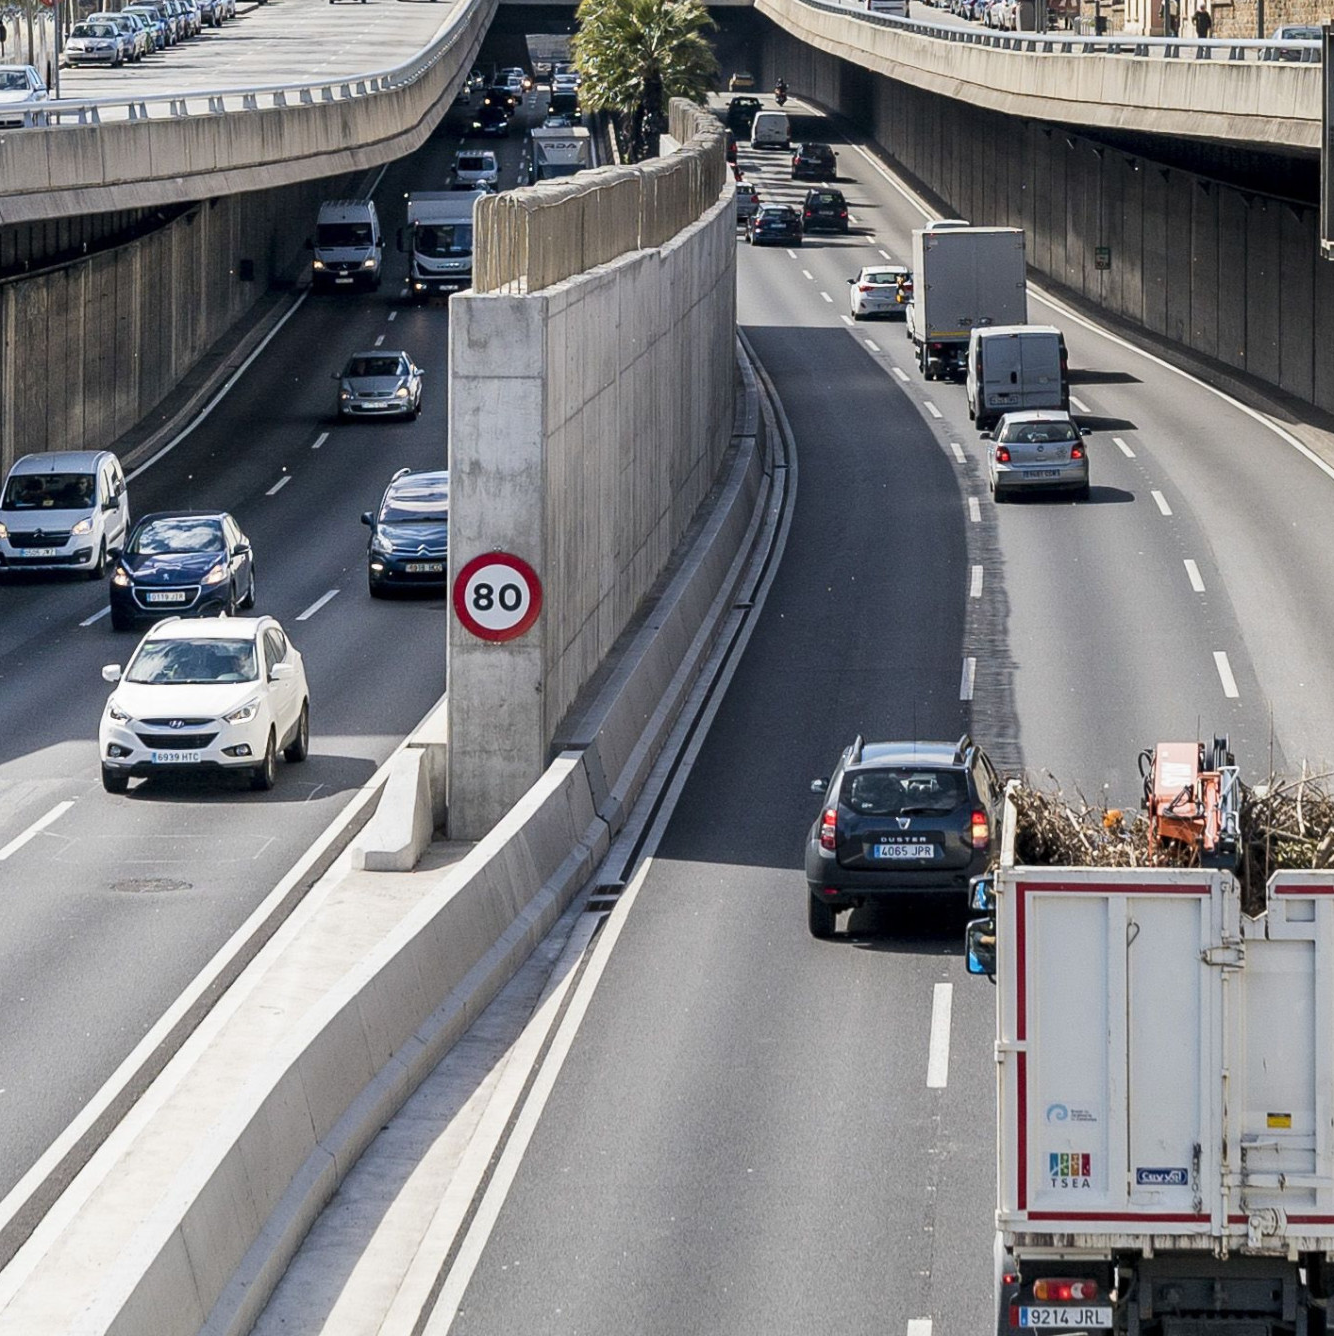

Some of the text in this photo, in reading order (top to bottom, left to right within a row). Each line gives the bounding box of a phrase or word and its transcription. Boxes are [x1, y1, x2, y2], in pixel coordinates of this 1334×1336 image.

[473, 582, 522, 612] 80
[157, 752, 199, 761] 6939 HTC
[881, 846, 931, 856] 4065 JPR
[1050, 1178, 1091, 1189] TSEA
[1031, 1309, 1104, 1325] 9214 JRL
